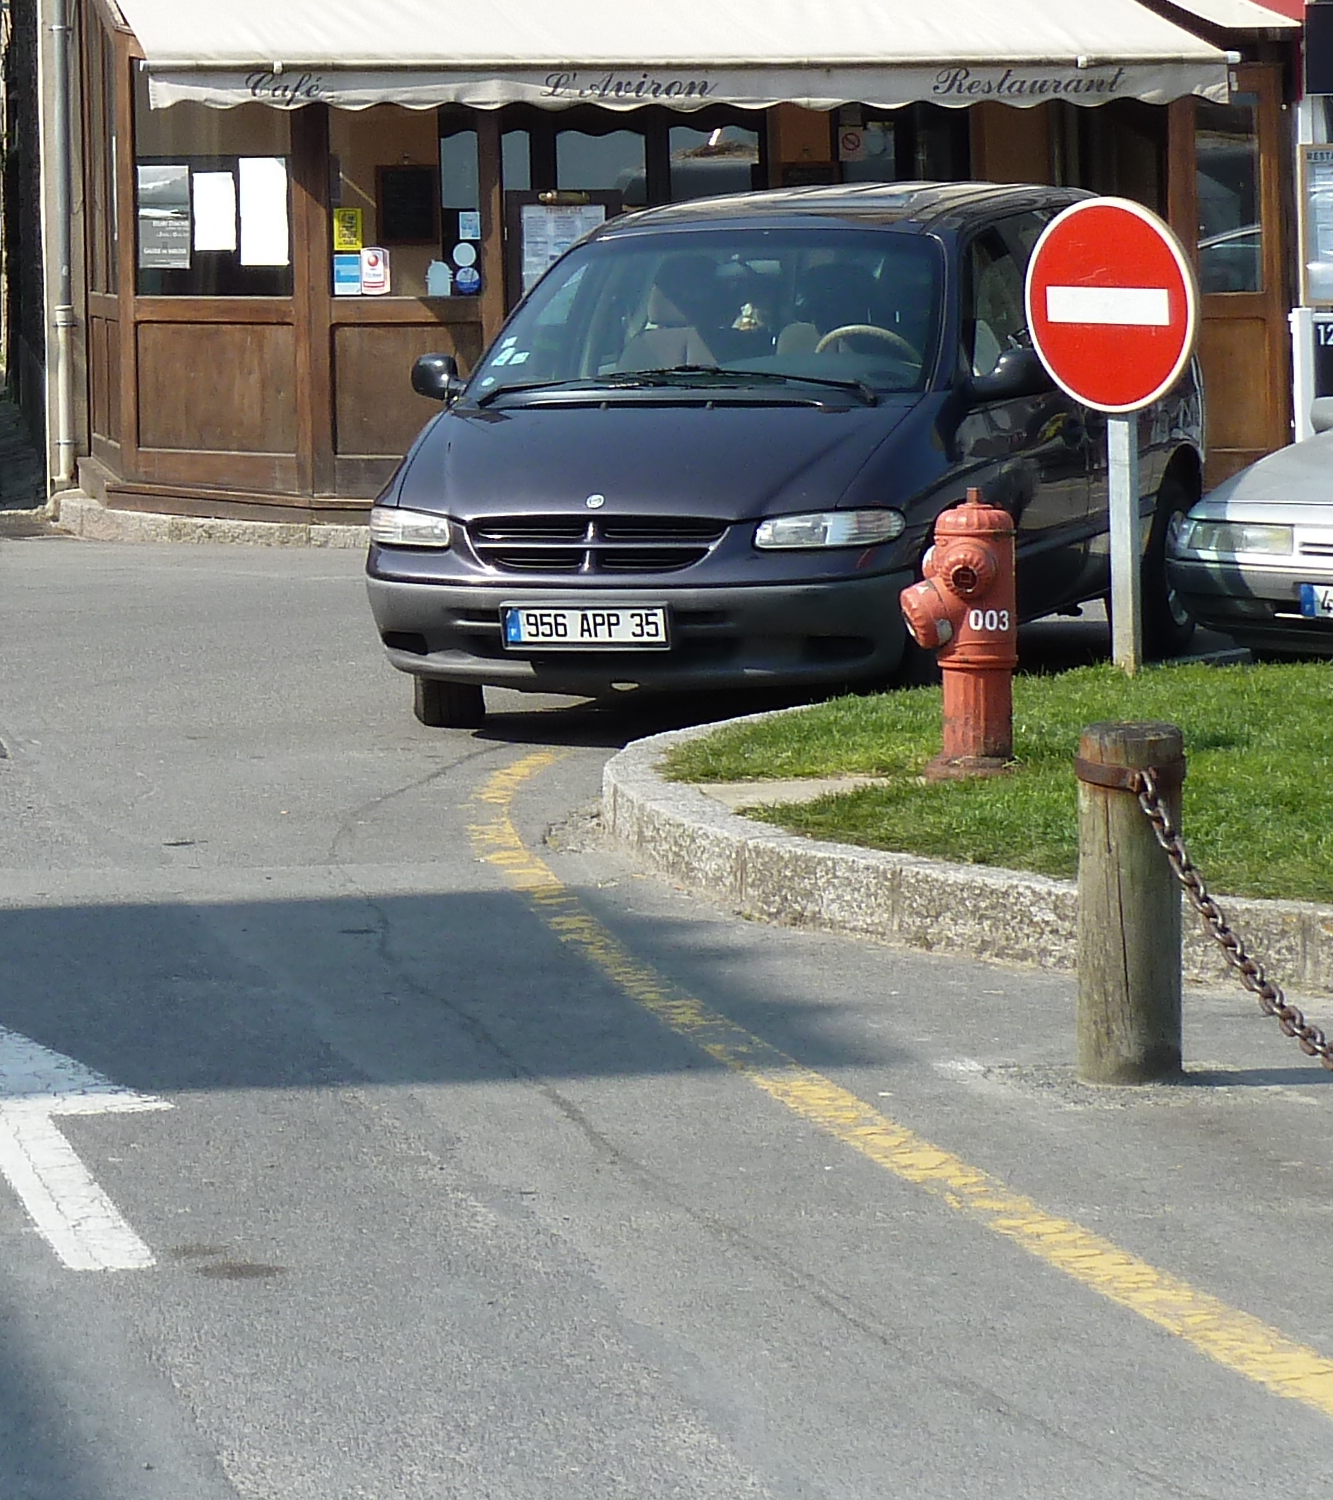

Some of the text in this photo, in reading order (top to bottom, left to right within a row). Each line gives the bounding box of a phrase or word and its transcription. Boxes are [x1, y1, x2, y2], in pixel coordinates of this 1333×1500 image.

[244, 72, 323, 107] Café
[540, 72, 719, 99] L'Aviron
[933, 67, 1125, 95] Restaurant
[526, 612, 659, 638] 956 APP 35
[969, 609, 1009, 631] 003
